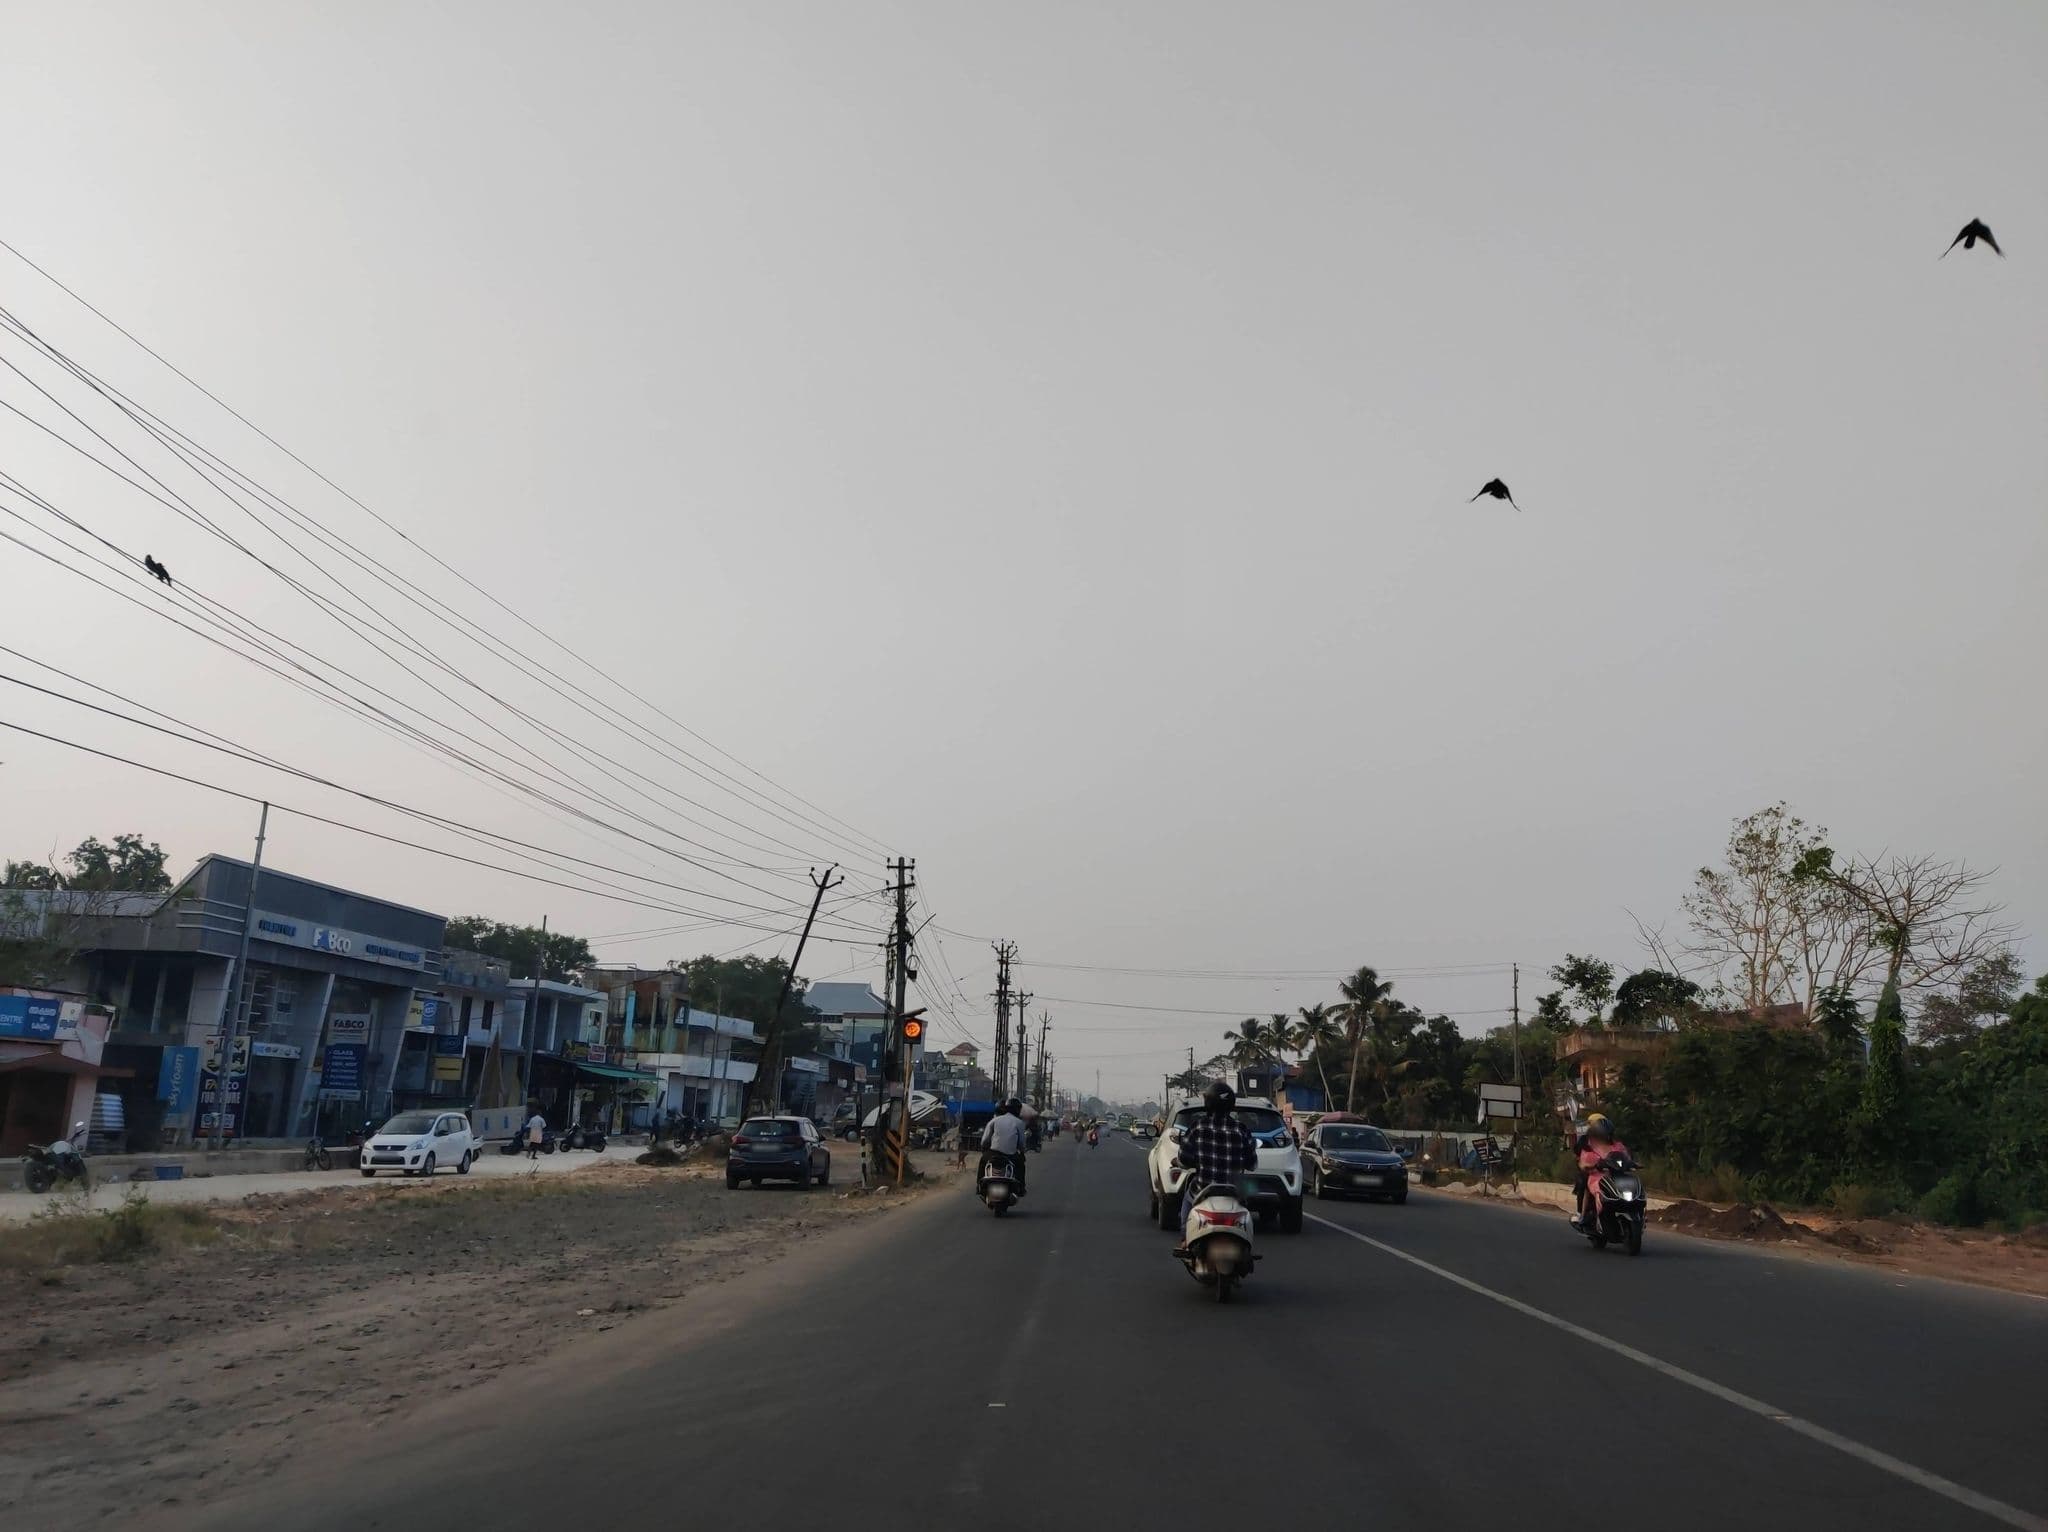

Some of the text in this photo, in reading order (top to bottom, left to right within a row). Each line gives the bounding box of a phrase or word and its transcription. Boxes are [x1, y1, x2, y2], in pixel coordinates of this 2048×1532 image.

[0, 1014, 24, 1024] ENTRE
[334, 1019, 365, 1029] FABCO
[205, 1078, 240, 1090] FACO
